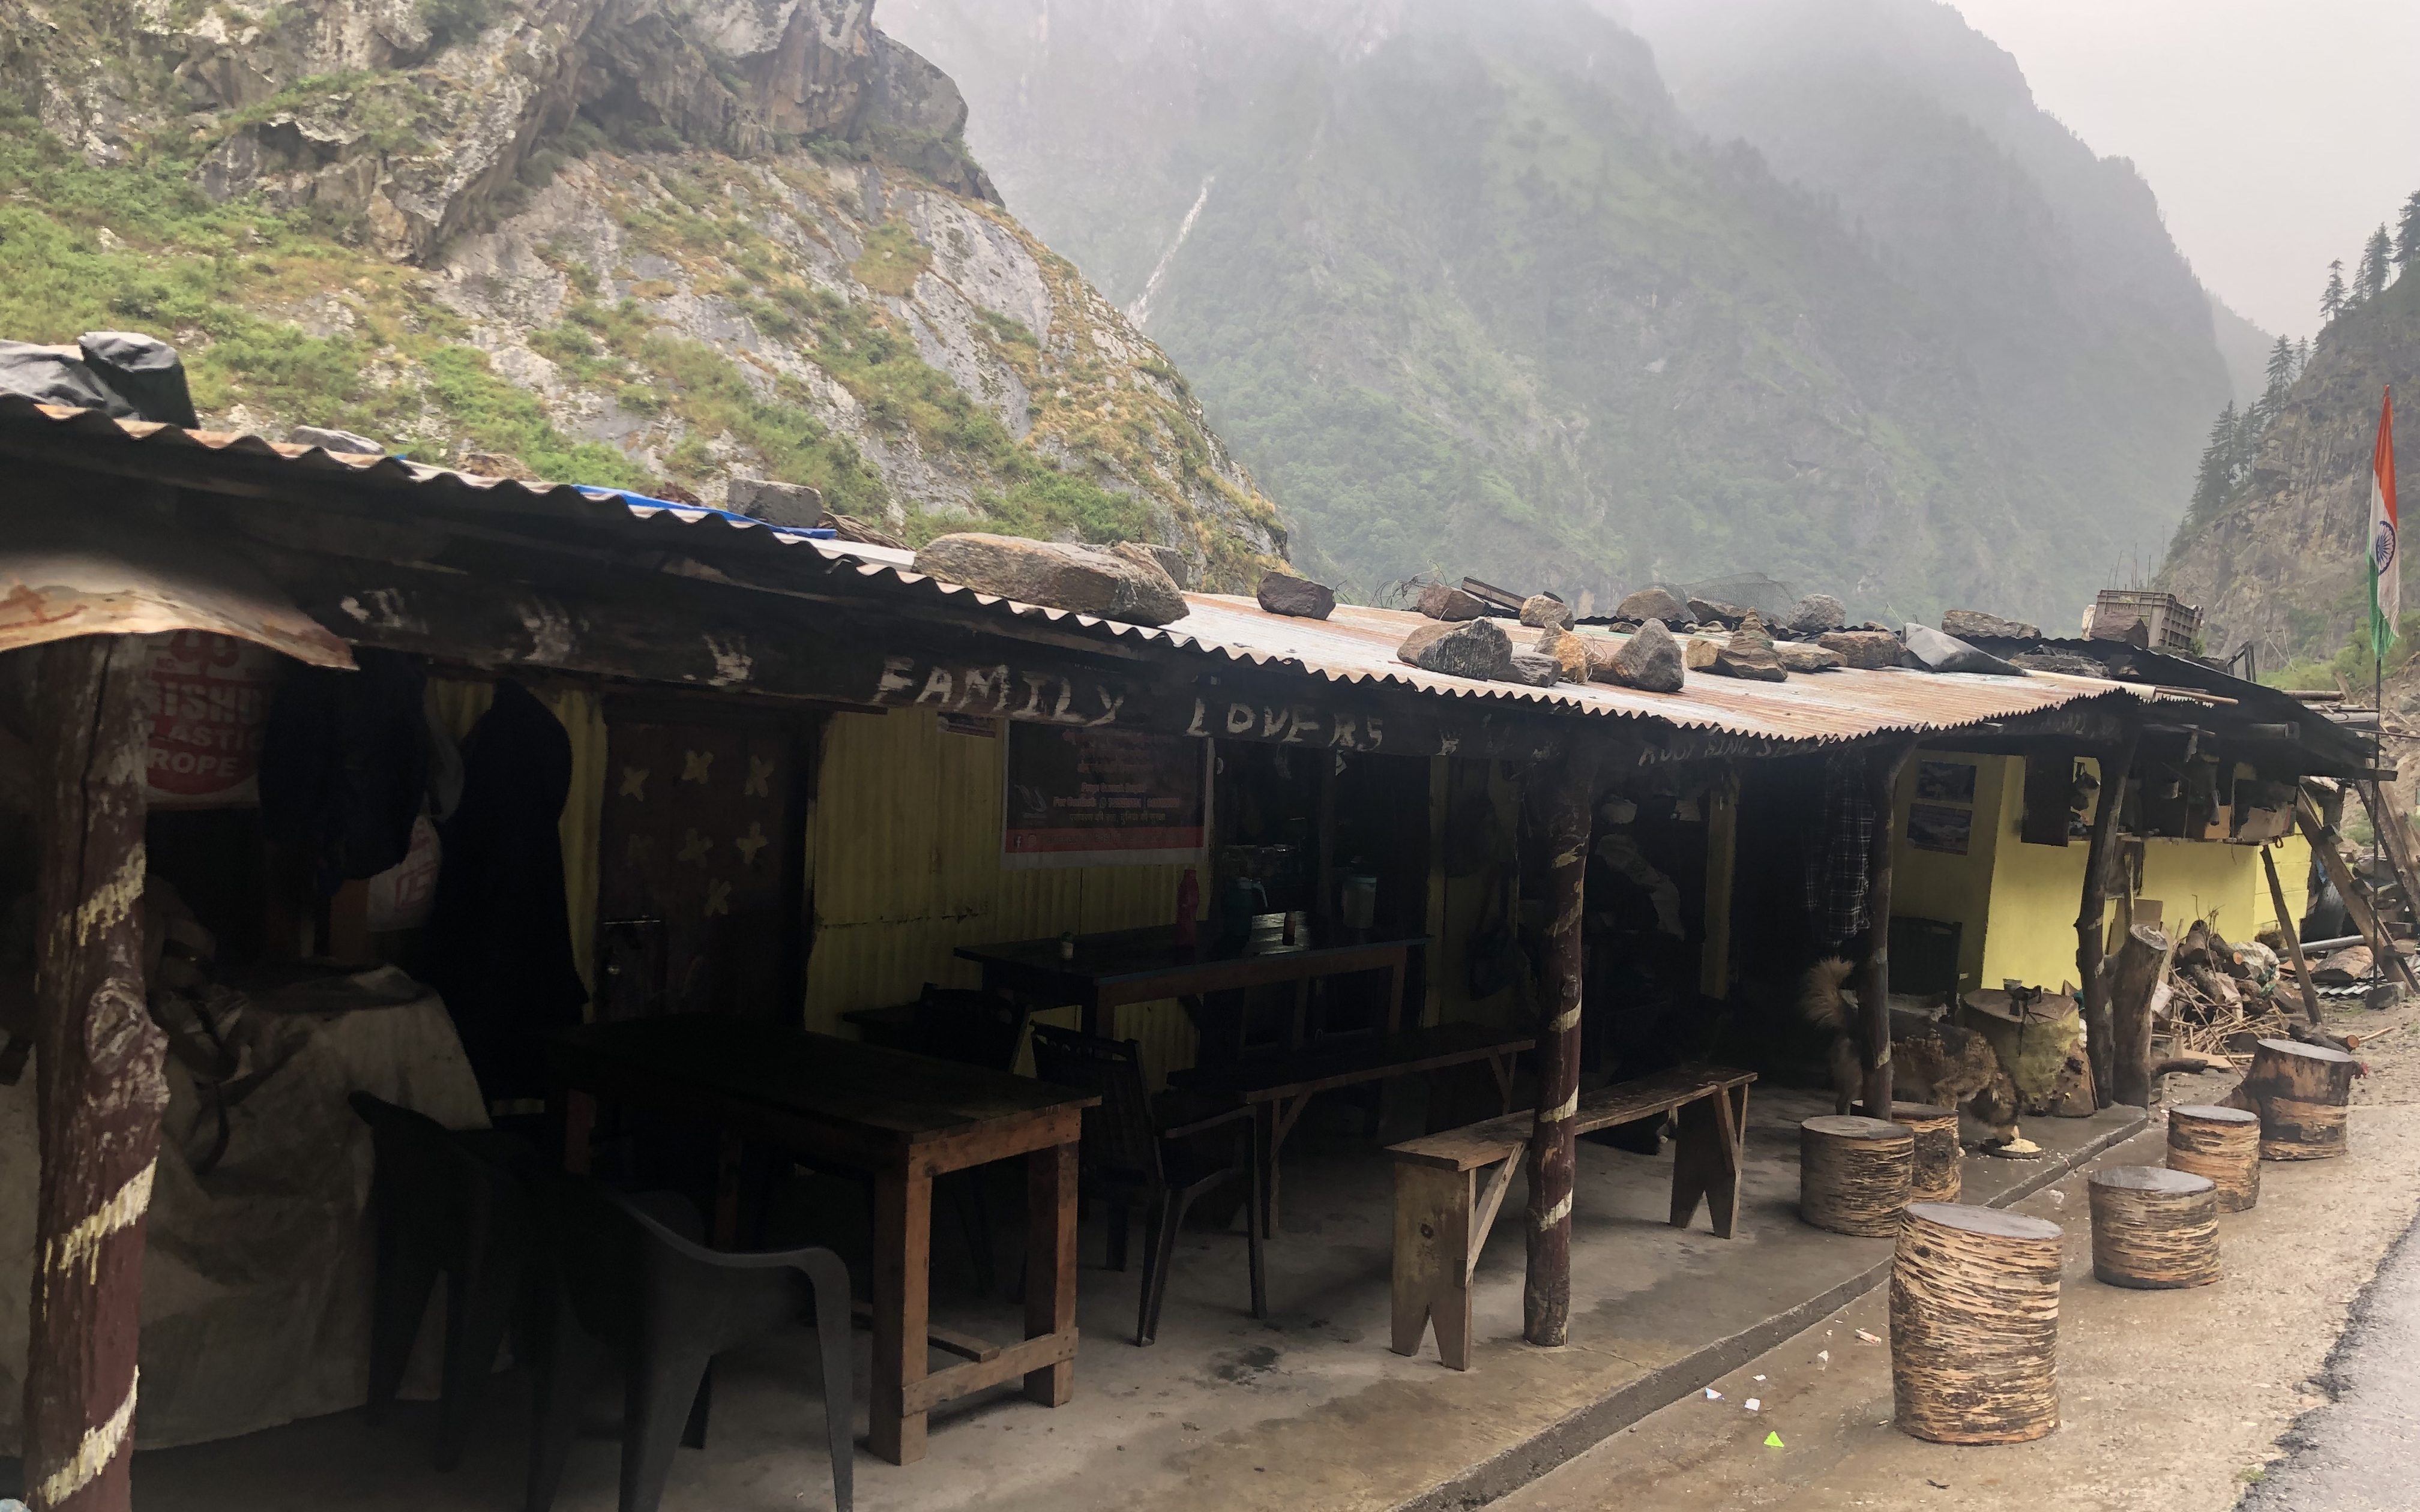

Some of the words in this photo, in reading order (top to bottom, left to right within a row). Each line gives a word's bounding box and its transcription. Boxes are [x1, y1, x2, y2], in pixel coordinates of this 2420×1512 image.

[869, 656, 1124, 727] FAMILY
[1182, 697, 1383, 752] LOVERS
[148, 746, 239, 776] ROPE
